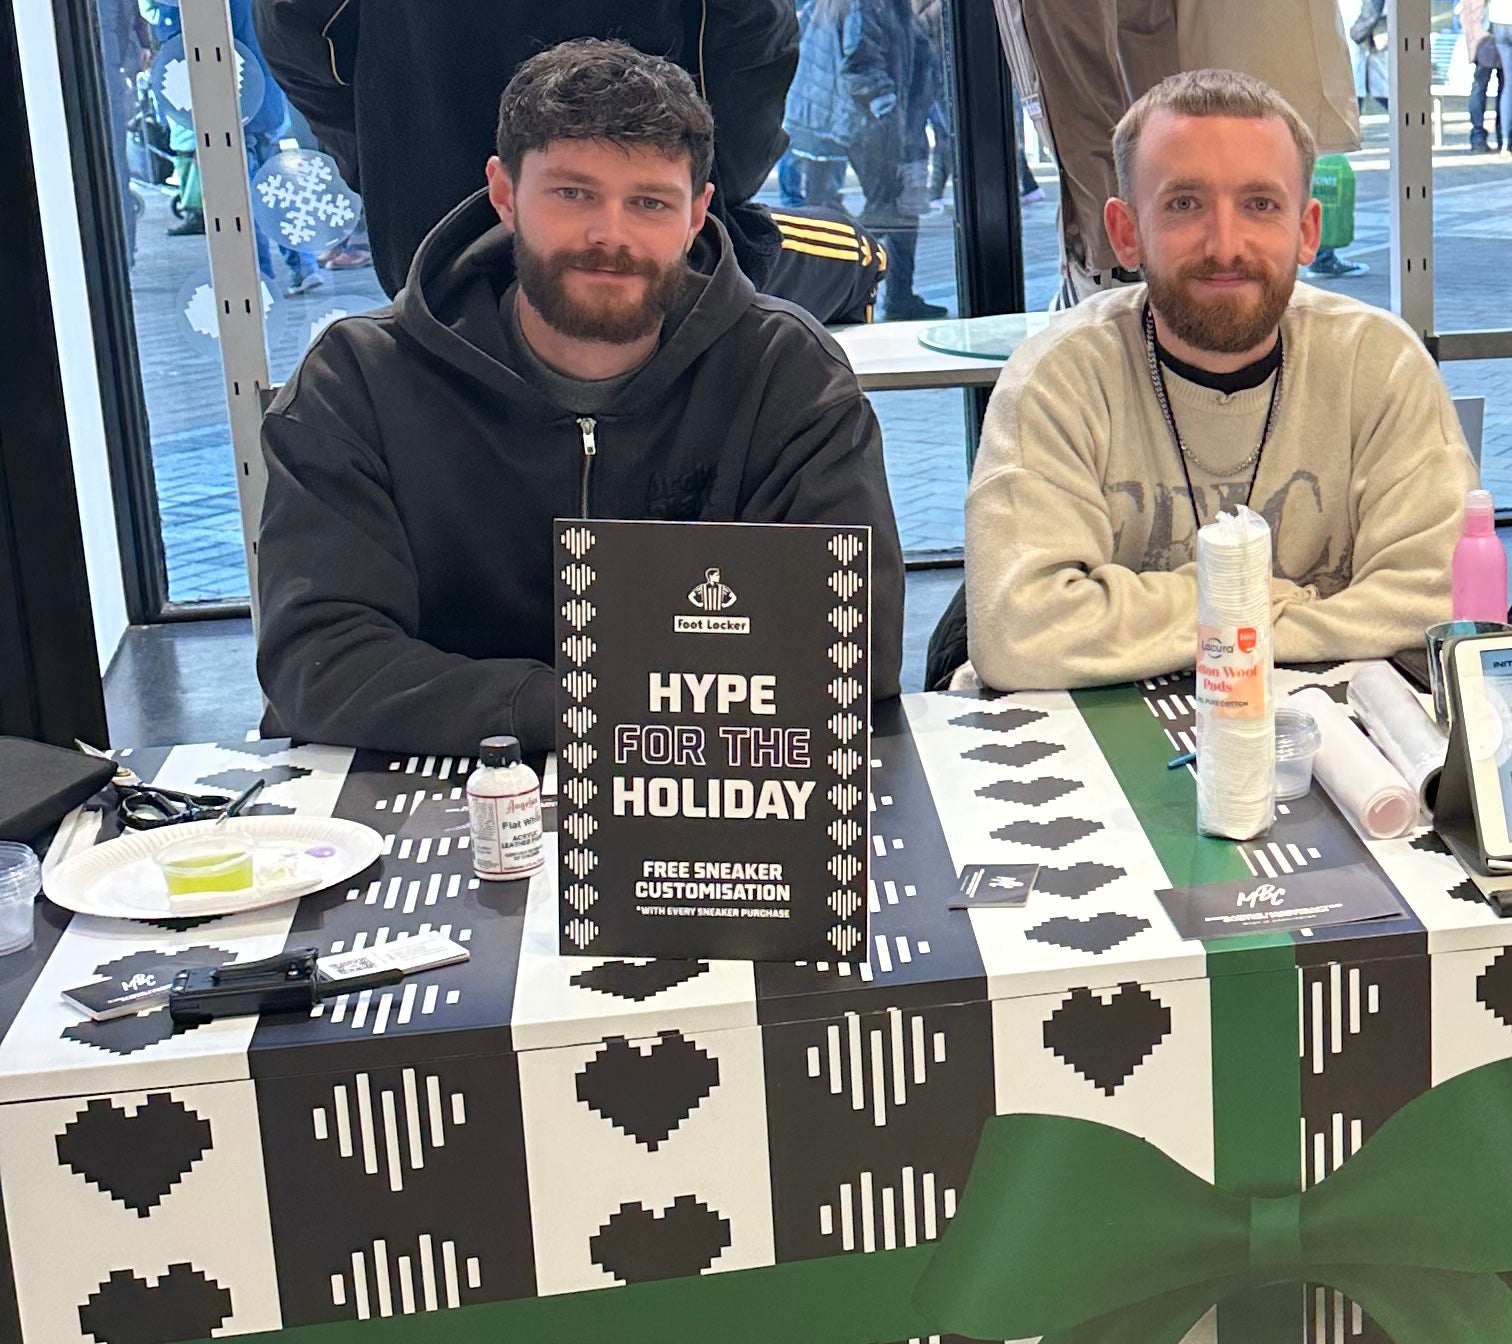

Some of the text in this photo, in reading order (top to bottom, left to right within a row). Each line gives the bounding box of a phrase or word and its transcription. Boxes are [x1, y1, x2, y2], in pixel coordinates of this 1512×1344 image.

[677, 617, 748, 633] Foot Locker
[1222, 665, 1258, 678] Wool
[649, 672, 777, 715] HYPE
[1203, 678, 1234, 693] Pads
[613, 724, 812, 769] FOR THE
[611, 776, 817, 821] HOLIDAY
[643, 860, 783, 881] FREE SNEAKER
[635, 881, 791, 902] CUSTOMISATION
[1237, 884, 1286, 909] MBC
[666, 906, 696, 917] EVERY
[697, 907, 739, 918] SNEAKER
[740, 908, 791, 919] PURCHASE
